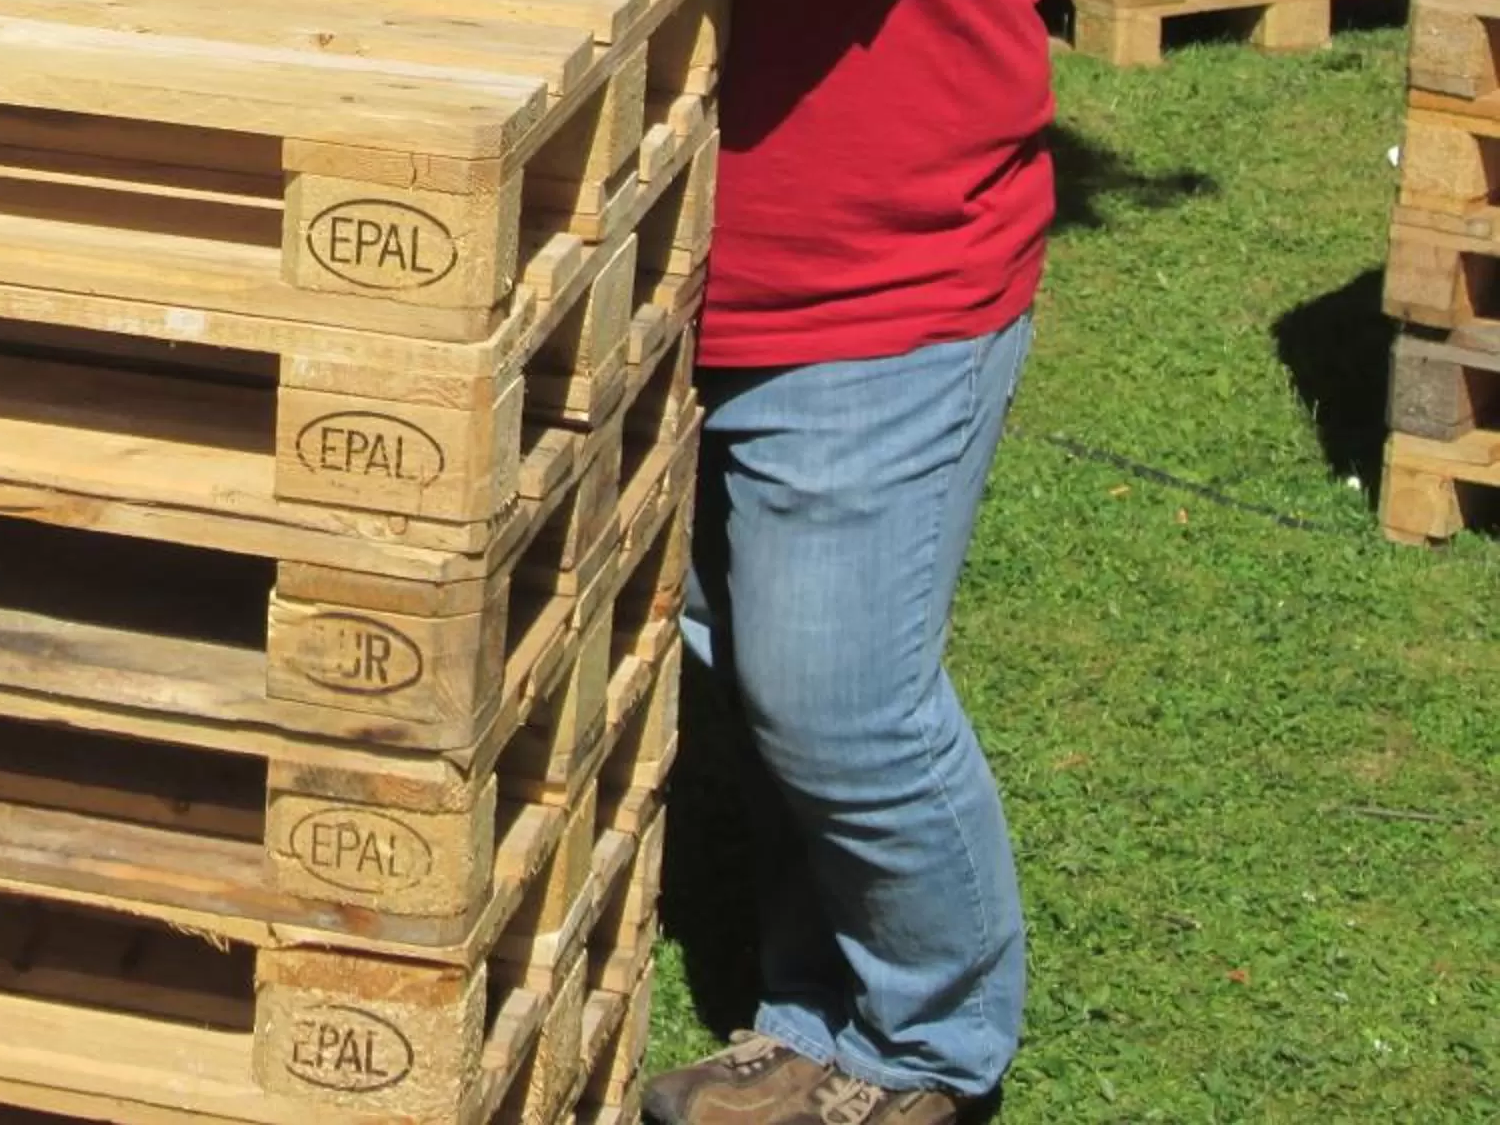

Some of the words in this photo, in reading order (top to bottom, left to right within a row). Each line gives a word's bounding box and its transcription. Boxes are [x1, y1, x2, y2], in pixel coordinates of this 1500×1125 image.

[330, 216, 434, 273] EPAL
[320, 427, 418, 480] EPAL
[310, 823, 405, 877] EPAL
[292, 1021, 388, 1077] EPAL
